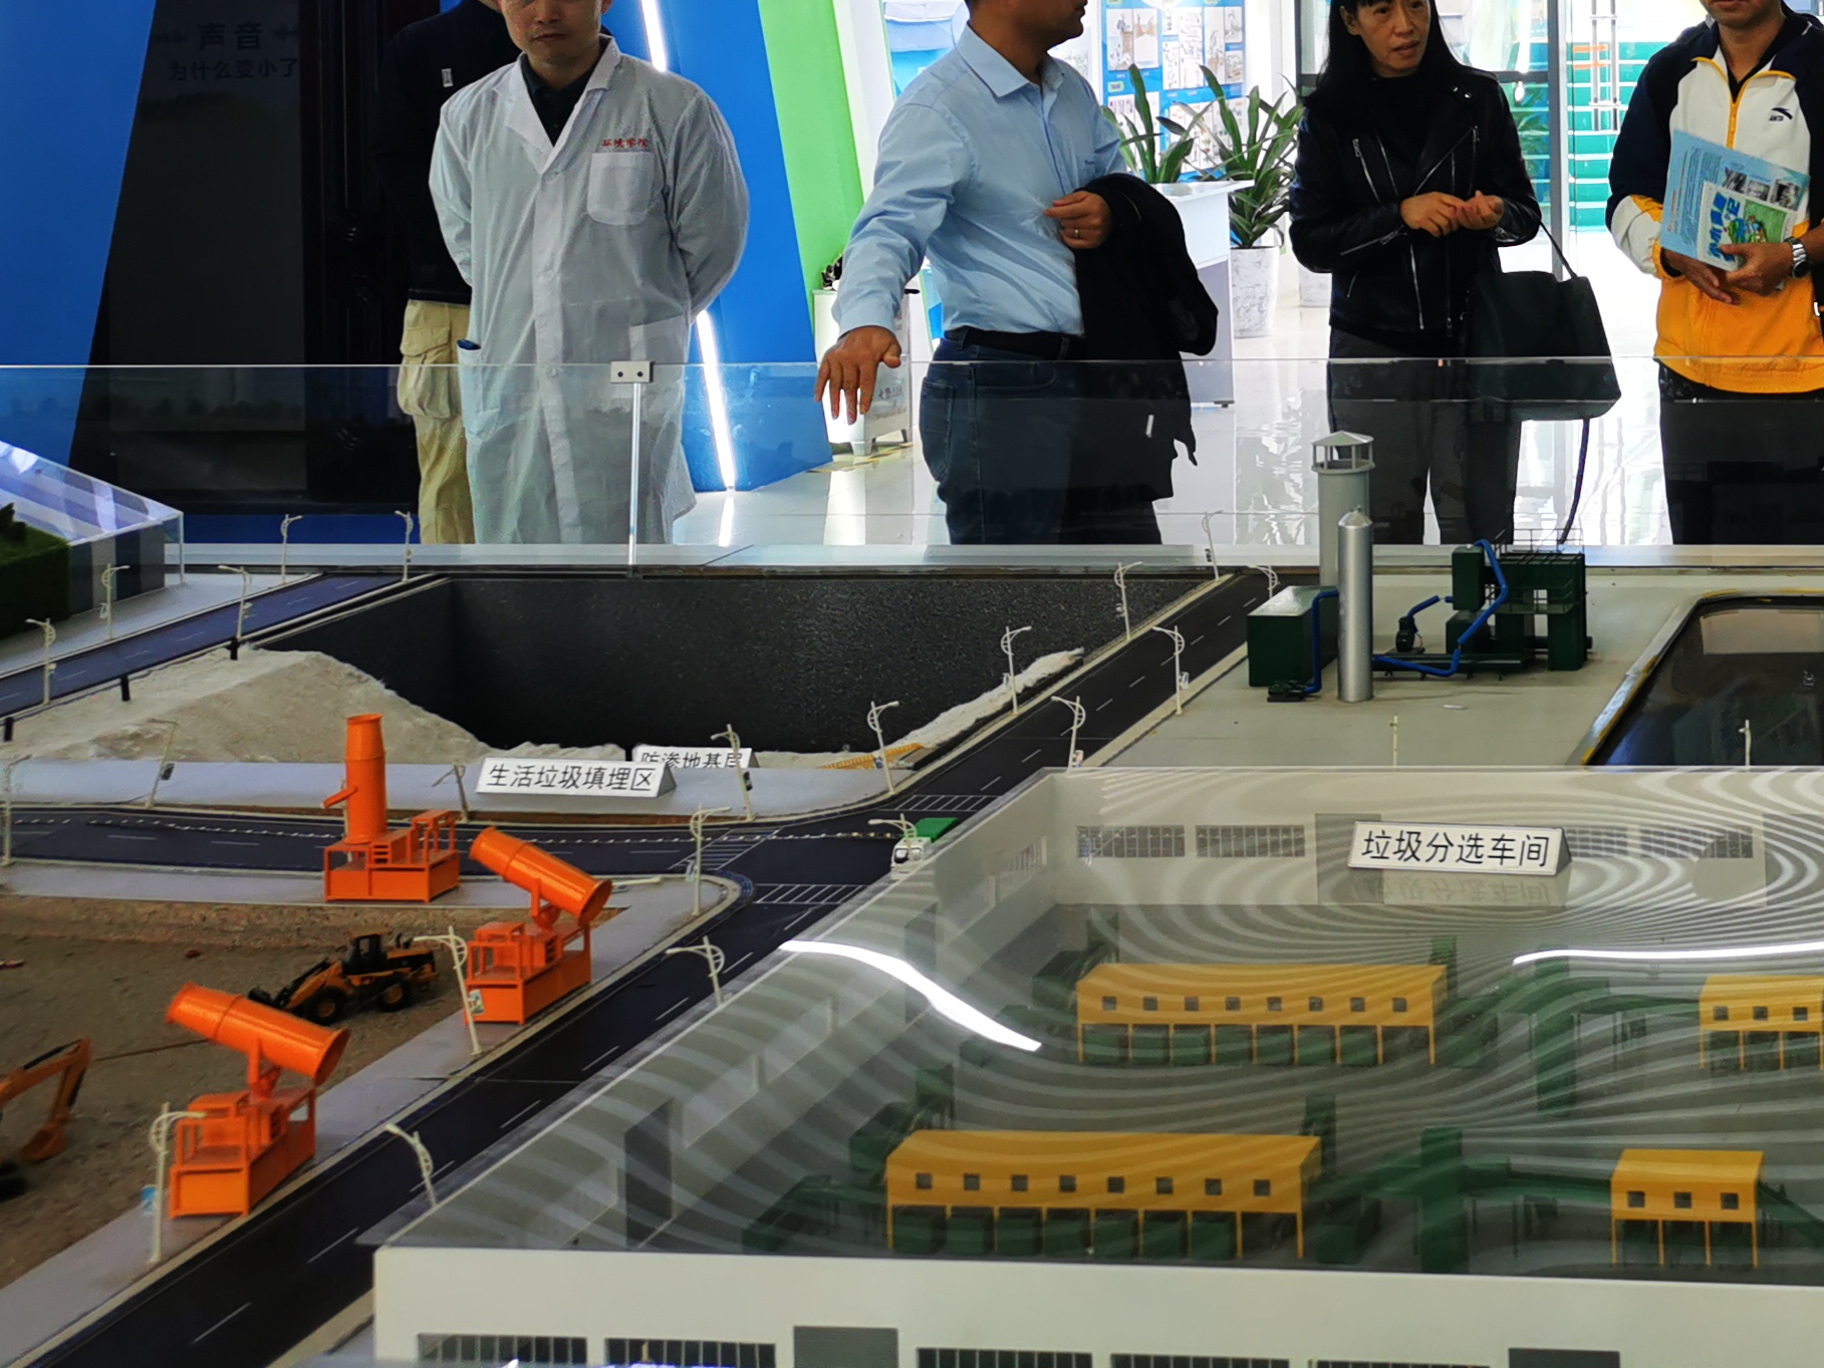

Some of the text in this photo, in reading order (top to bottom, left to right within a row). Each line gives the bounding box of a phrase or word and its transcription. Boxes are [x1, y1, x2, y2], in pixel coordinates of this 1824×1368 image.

[197, 21, 263, 51] 声音
[169, 58, 298, 81] 为什么变小了
[486, 764, 655, 792] 生活垃圾填埋区
[1361, 829, 1550, 868] 垃圾分选车间
